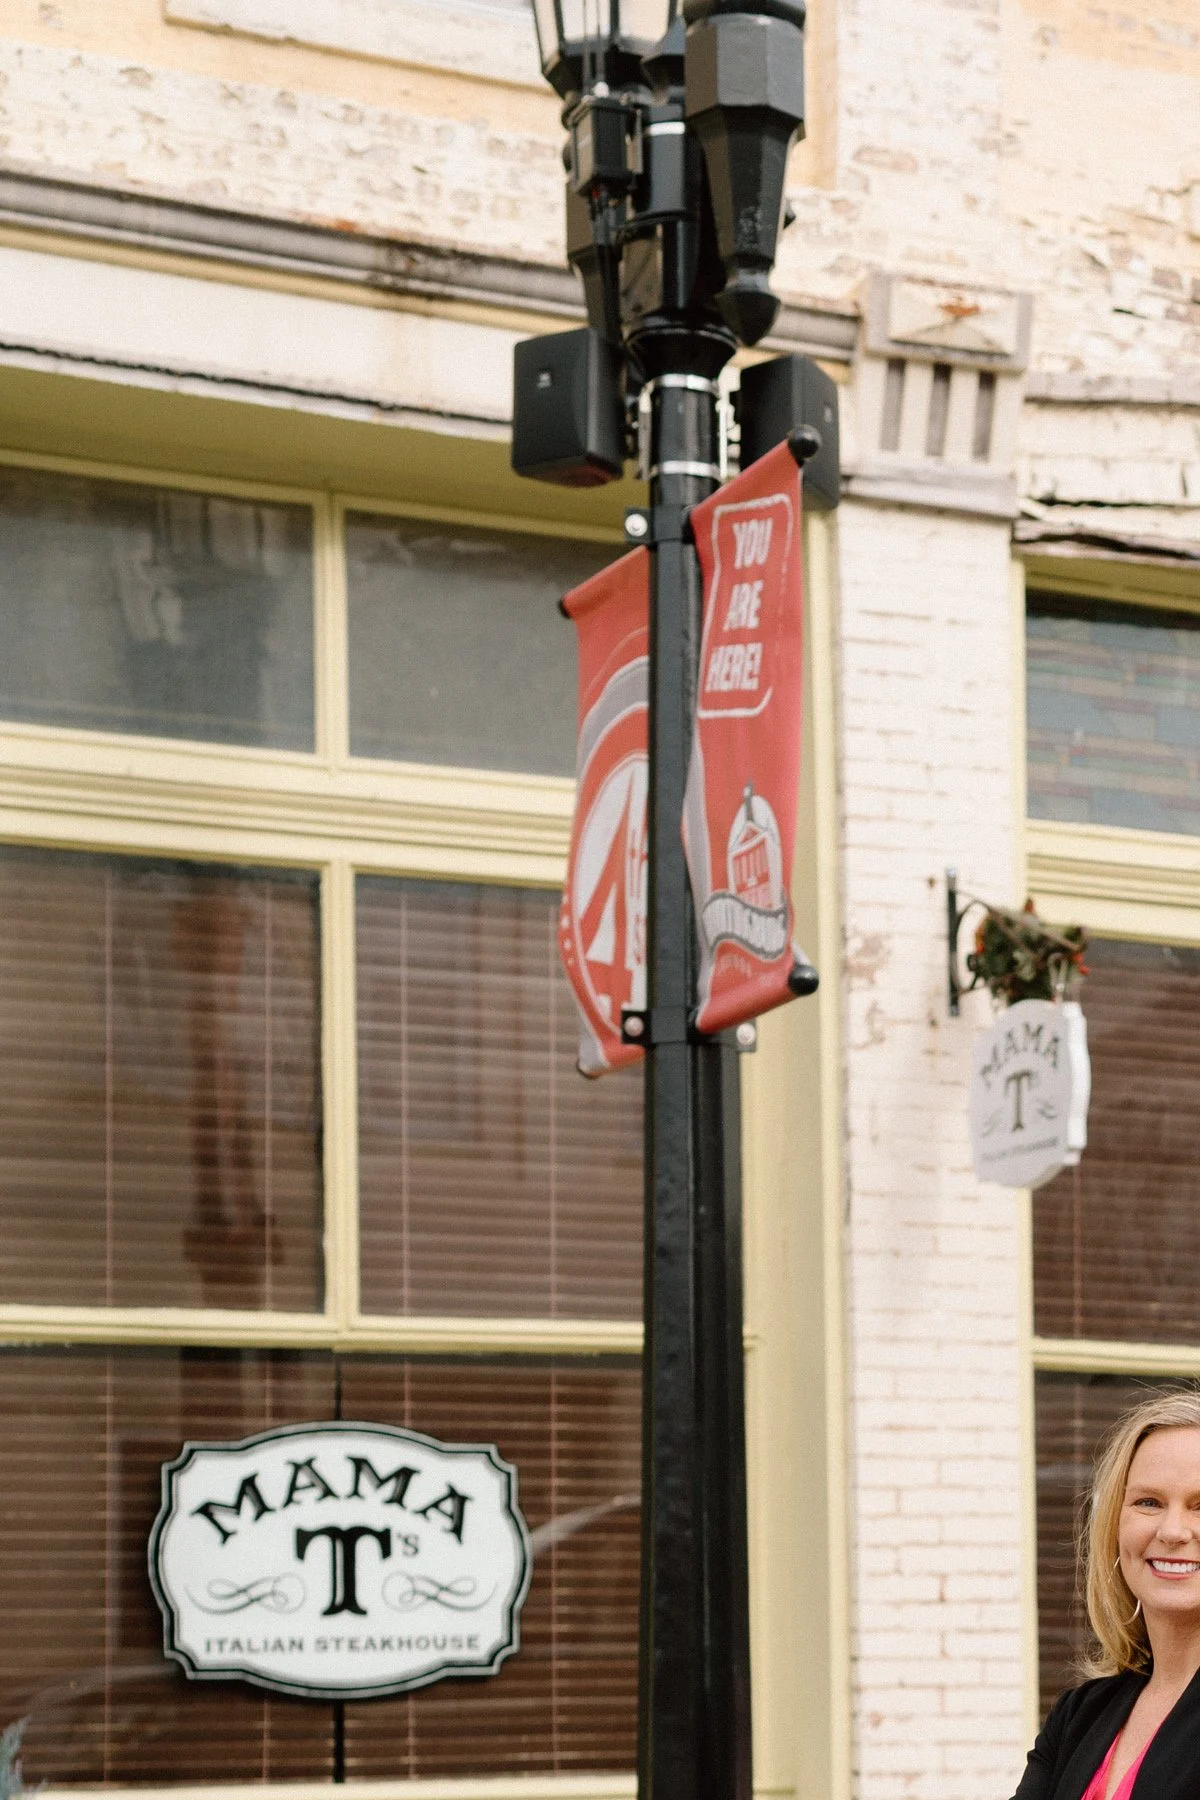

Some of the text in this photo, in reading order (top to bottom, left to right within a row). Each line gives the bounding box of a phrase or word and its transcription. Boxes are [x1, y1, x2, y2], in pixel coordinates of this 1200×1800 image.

[732, 518, 773, 570] YOU
[723, 579, 765, 632] ARE
[704, 642, 763, 692] HERE!
[190, 1456, 473, 1545] MAMA
[205, 1633, 480, 1654] ITALIAN STEAKHOUSE
